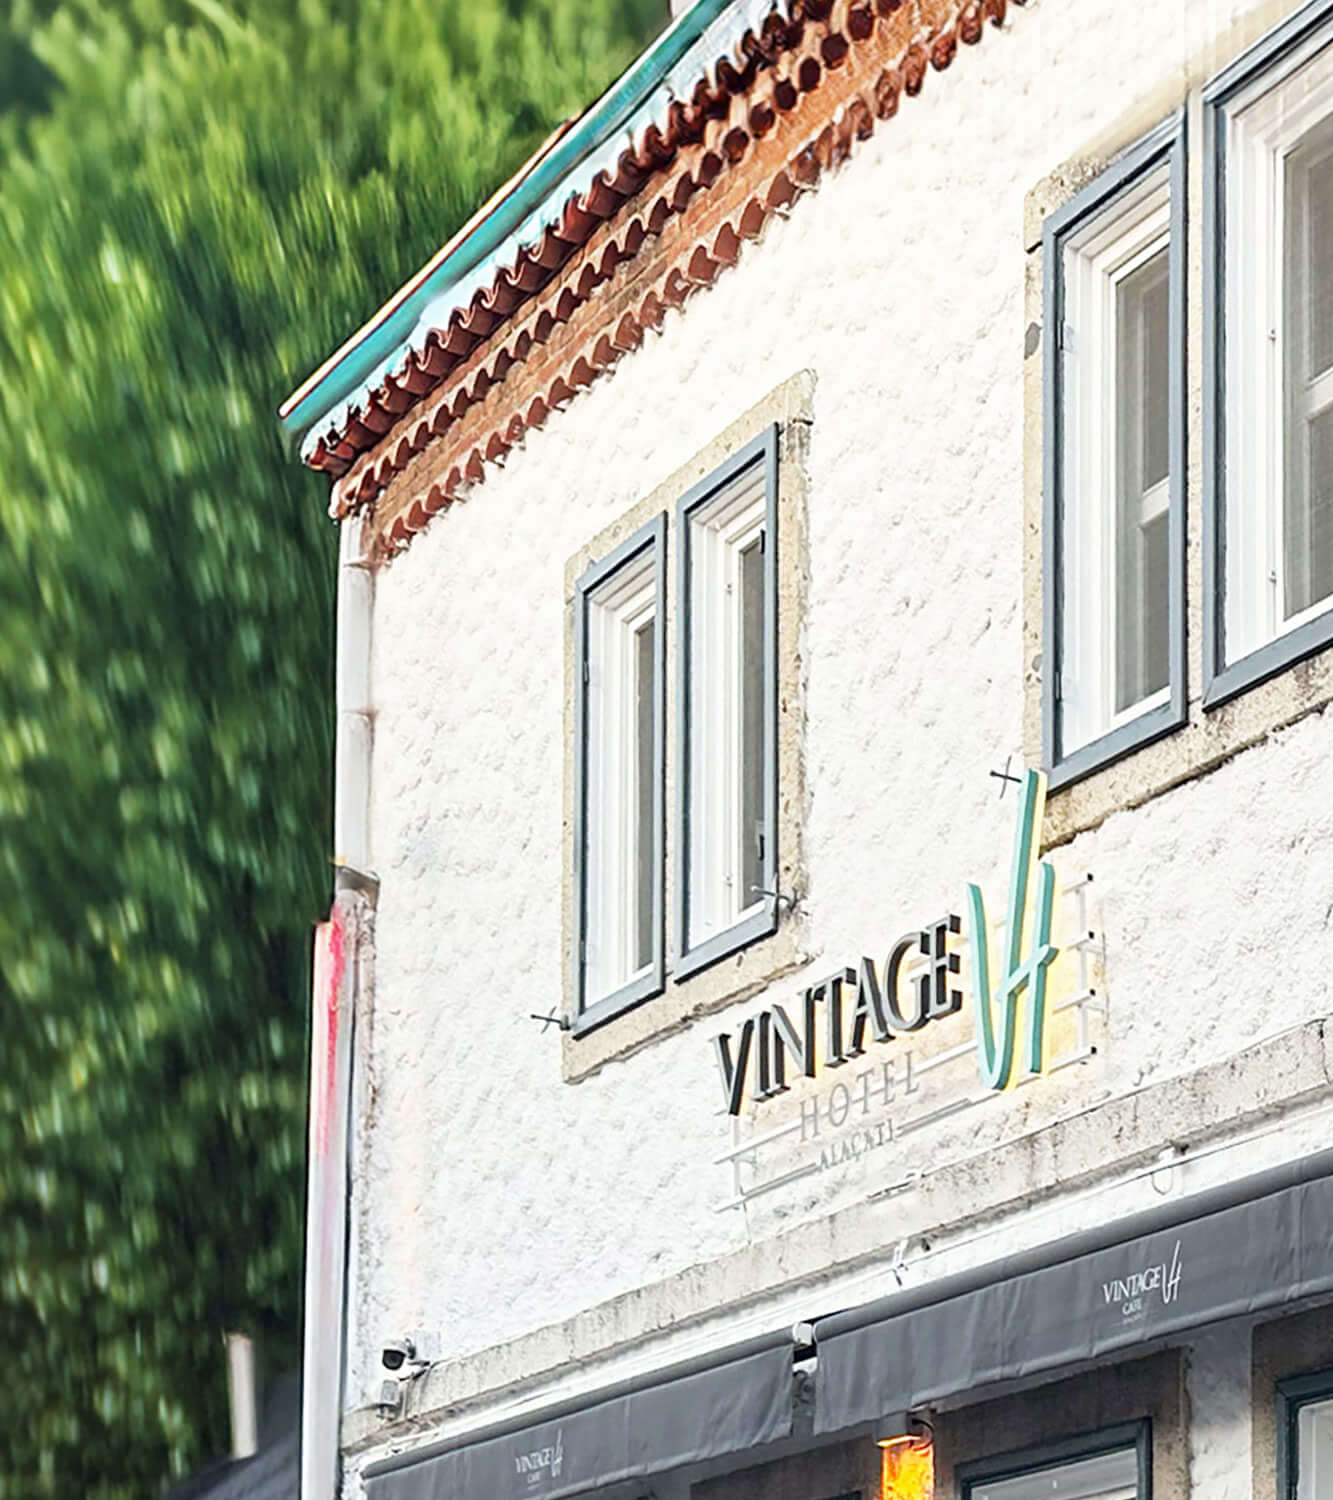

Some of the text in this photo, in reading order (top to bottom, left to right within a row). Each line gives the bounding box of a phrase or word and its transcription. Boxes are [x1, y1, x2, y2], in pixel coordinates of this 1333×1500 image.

[709, 914, 963, 1116] VINTAGE
[800, 1051, 920, 1141] HOTEL
[819, 1118, 894, 1173] ALAÇATI
[1103, 1266, 1161, 1303] VINTAGE
